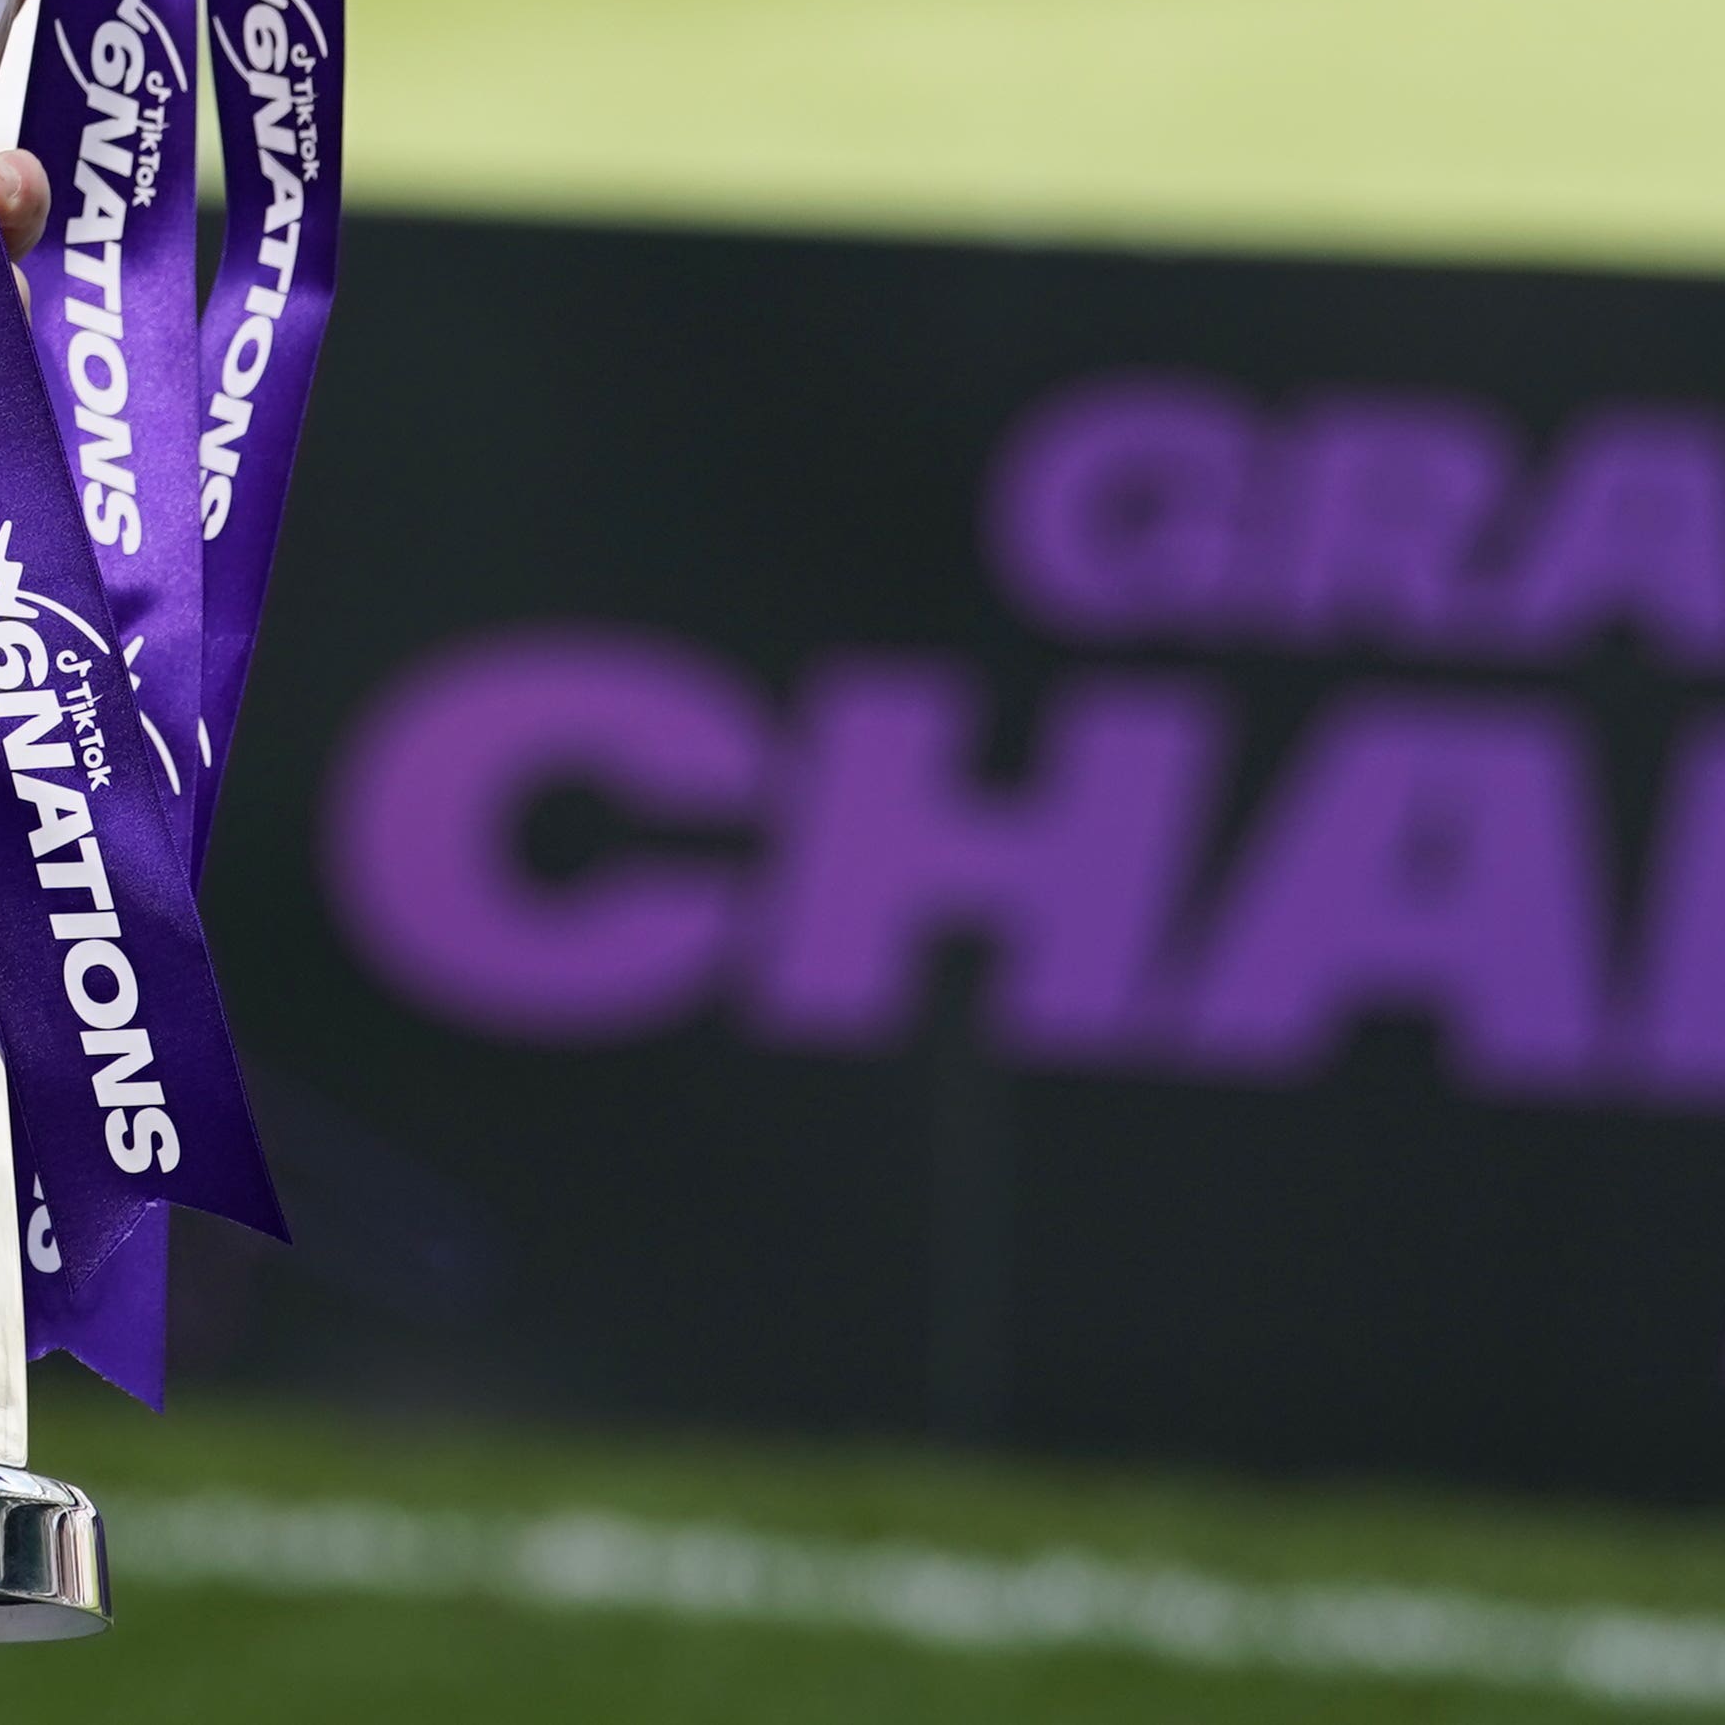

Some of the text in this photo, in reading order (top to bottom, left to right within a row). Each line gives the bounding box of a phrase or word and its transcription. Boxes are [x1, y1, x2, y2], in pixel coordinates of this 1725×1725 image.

[131, 102, 166, 208] TikTok
[292, 78, 321, 183] TikTok
[62, 681, 112, 791] TikTok
[330, 625, 1725, 1105] CHA
